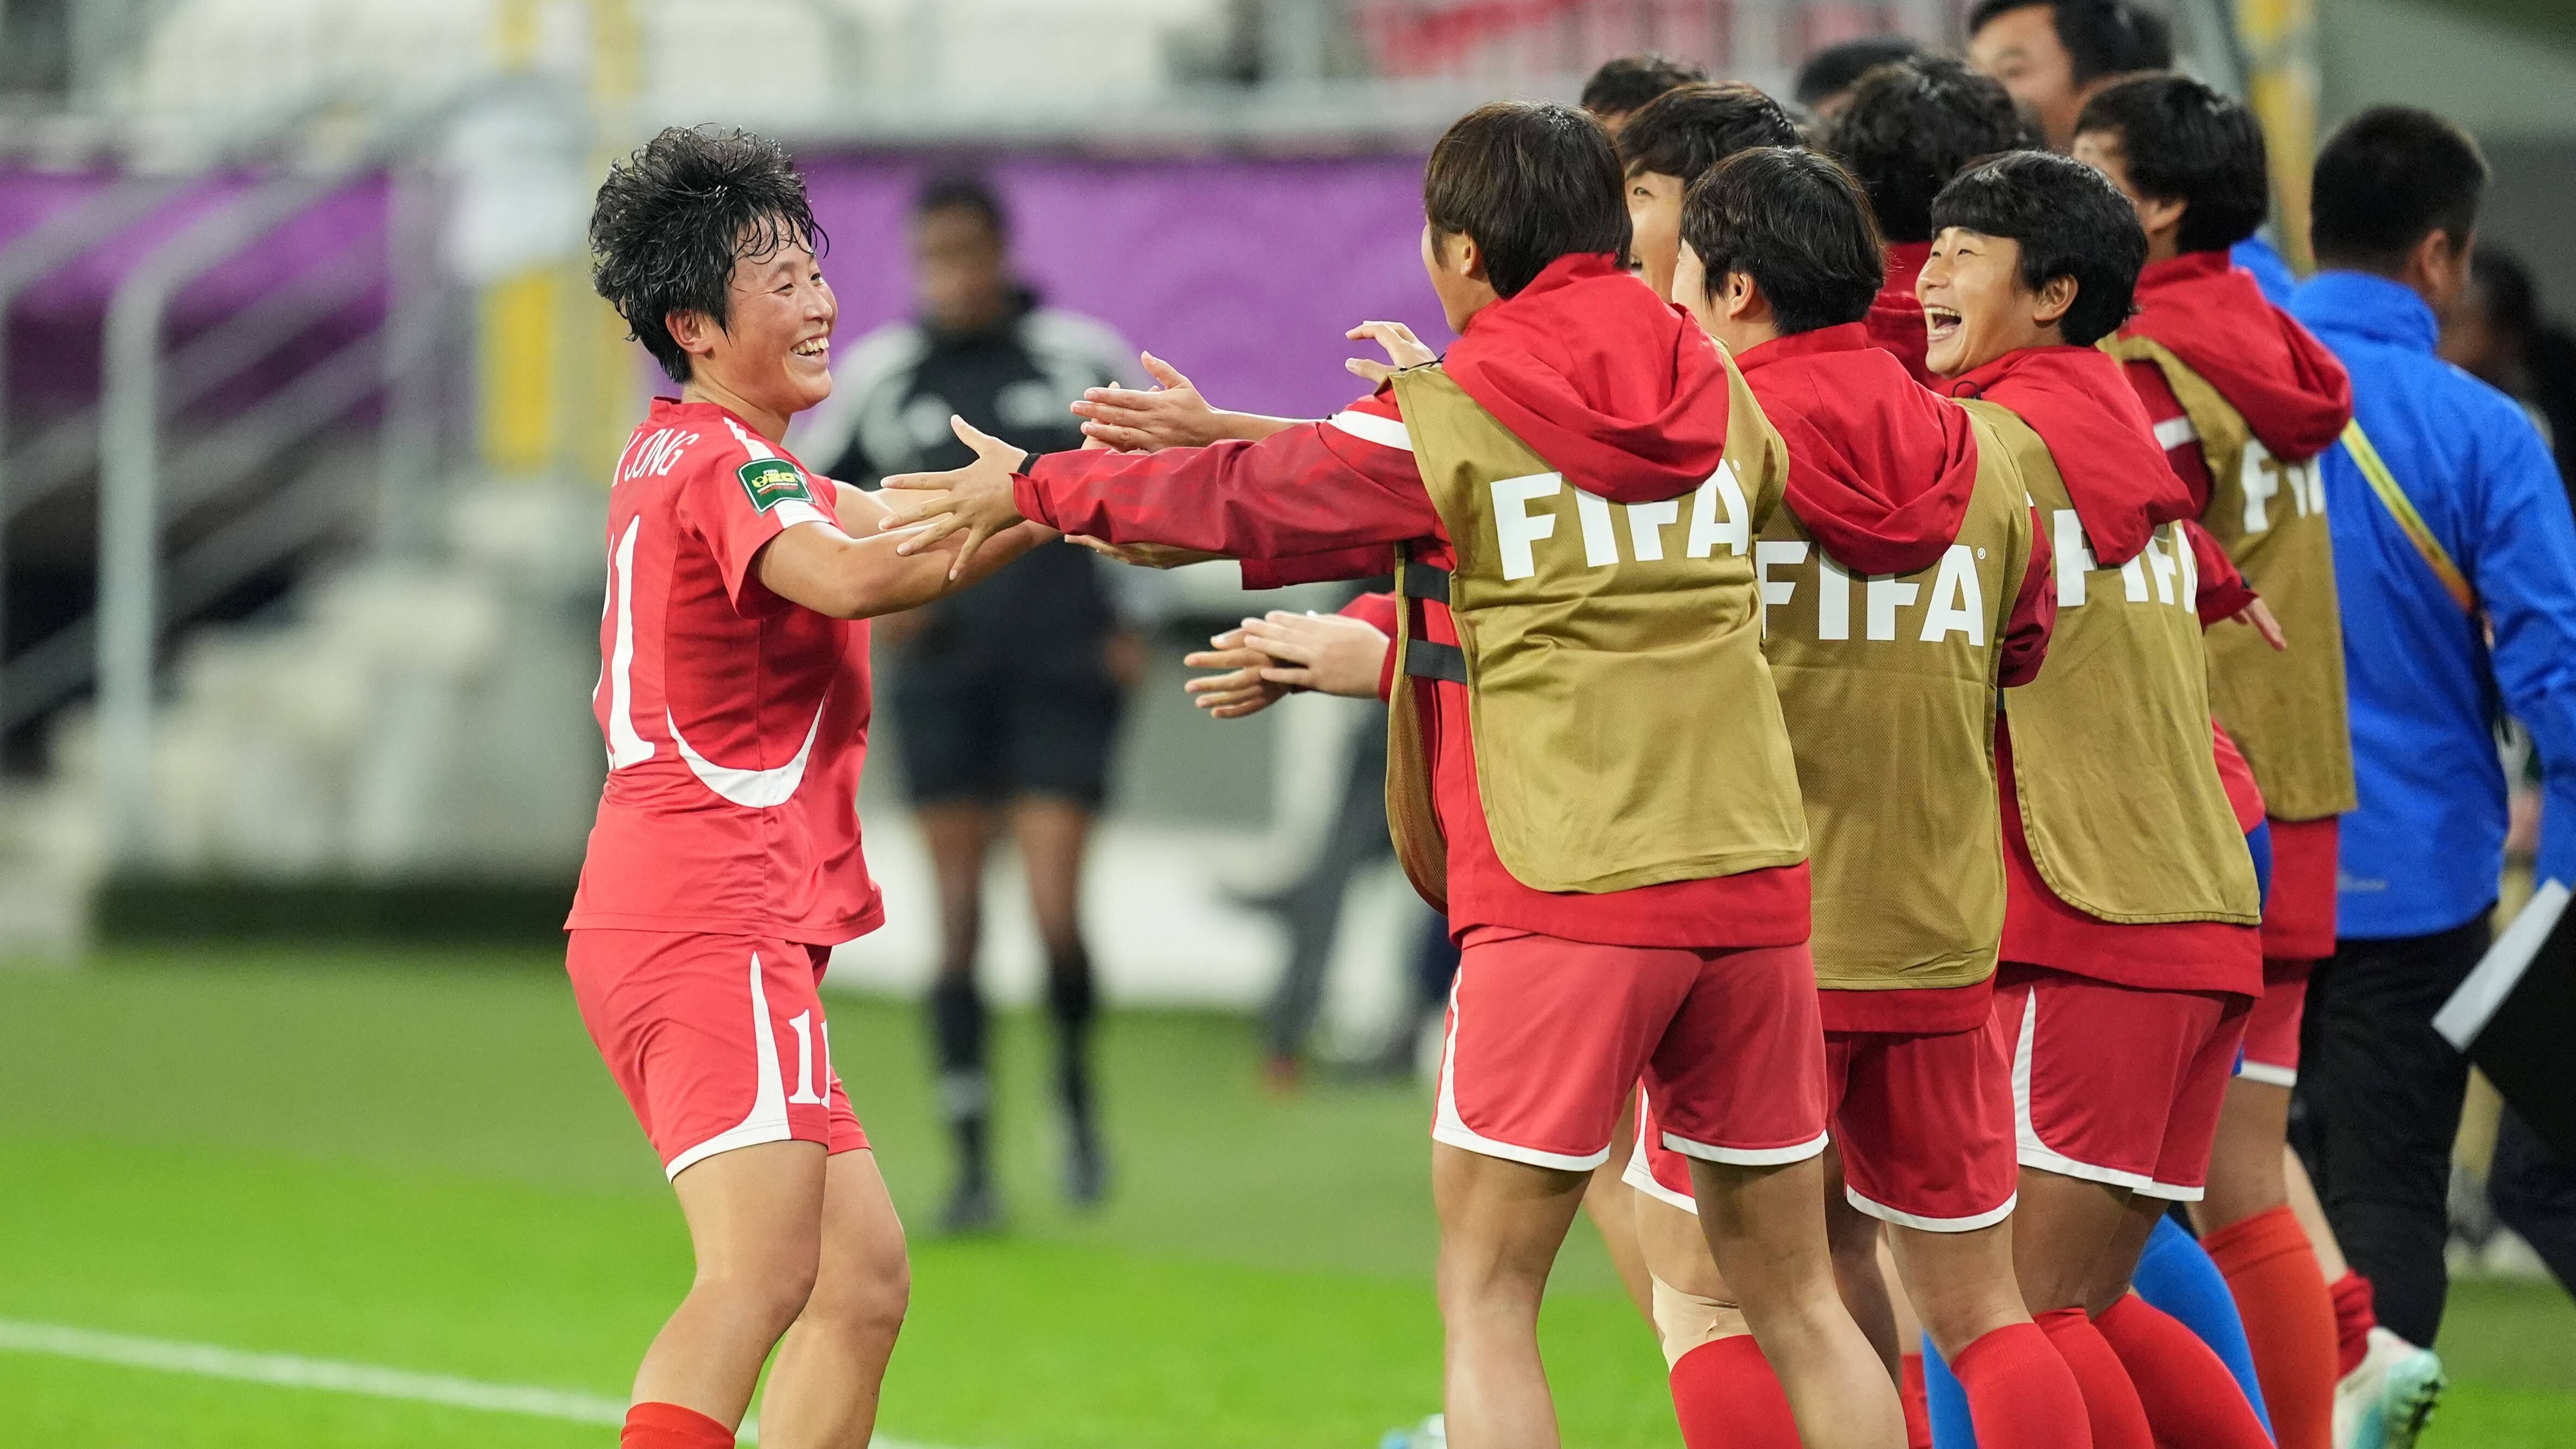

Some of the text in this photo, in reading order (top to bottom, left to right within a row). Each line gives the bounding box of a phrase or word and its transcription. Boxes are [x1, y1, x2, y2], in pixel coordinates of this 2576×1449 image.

[624, 428, 700, 482] JONG
[1490, 458, 1749, 580] FIFA
[592, 515, 655, 772] 1
[1755, 541, 1985, 647] FIFA
